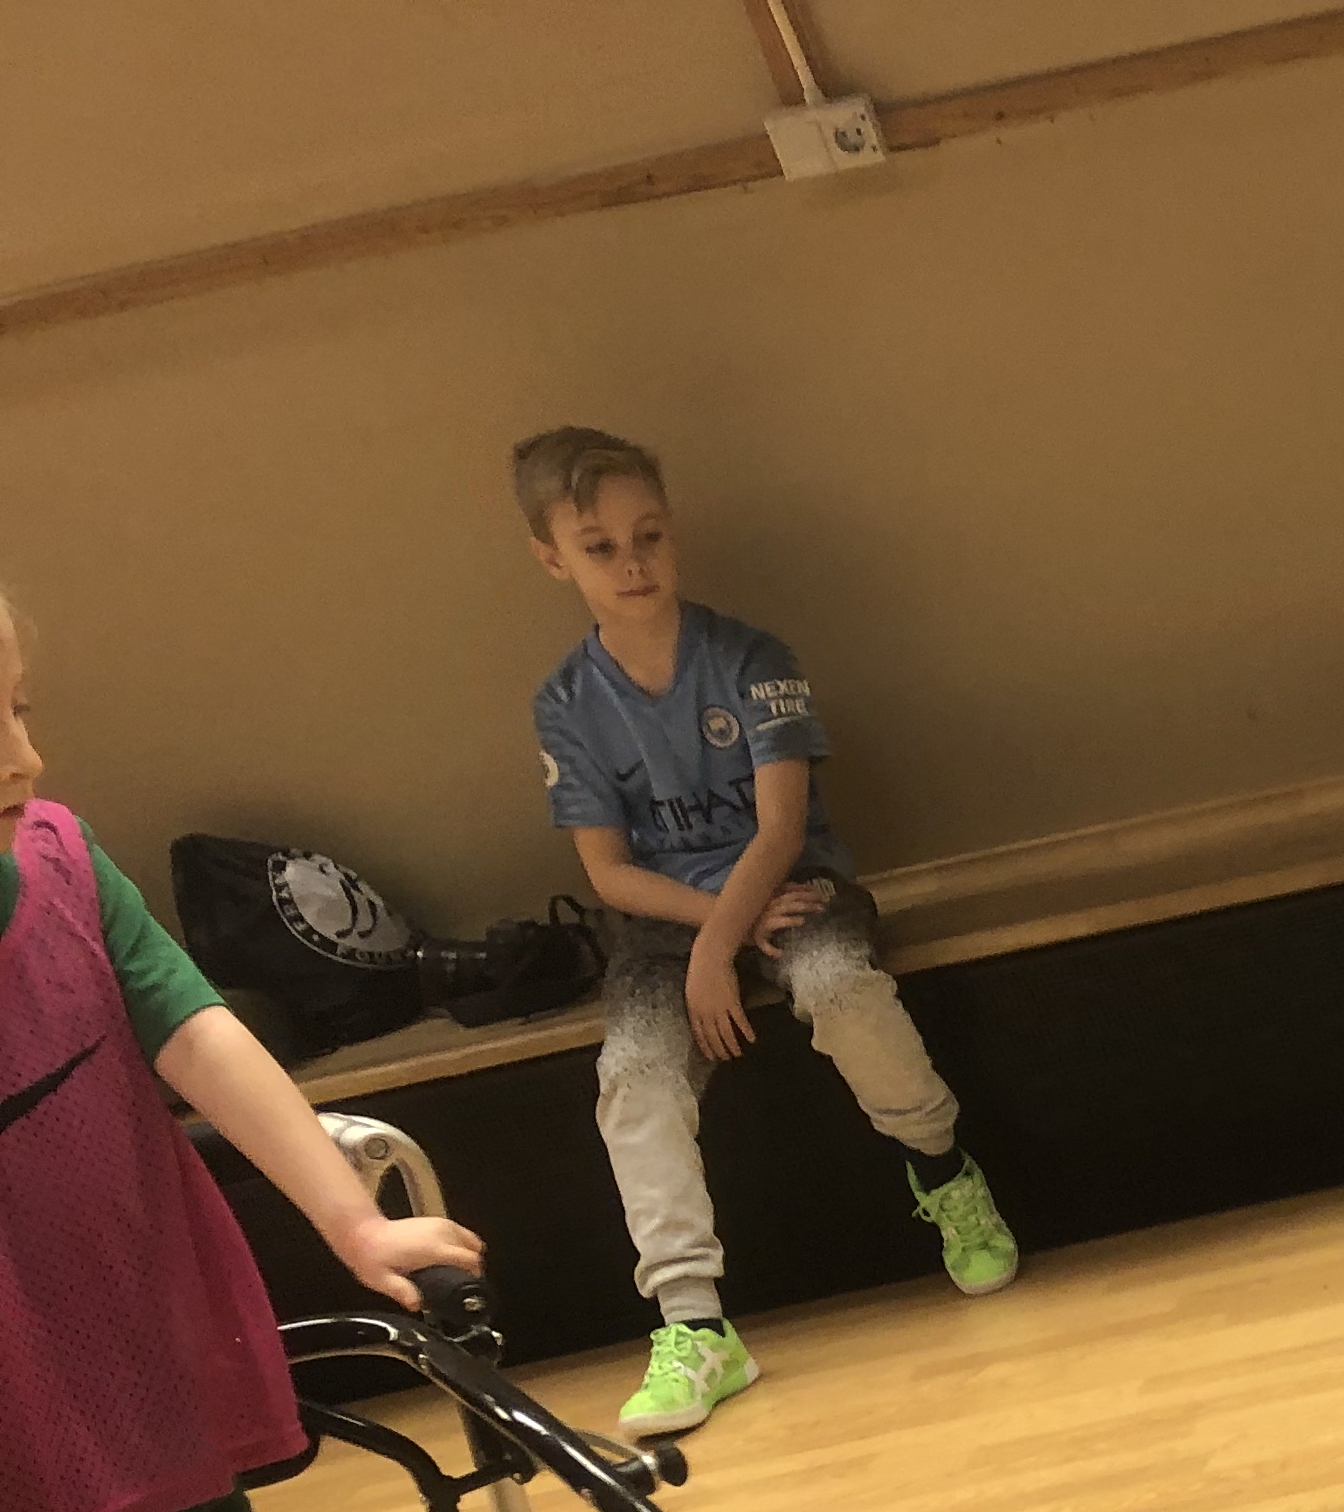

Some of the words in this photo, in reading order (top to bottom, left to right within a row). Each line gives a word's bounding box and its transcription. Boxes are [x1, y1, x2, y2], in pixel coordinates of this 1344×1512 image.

[750, 679, 811, 700] NEXEN
[770, 698, 809, 717] TIRE
[649, 774, 756, 831] TIHA
